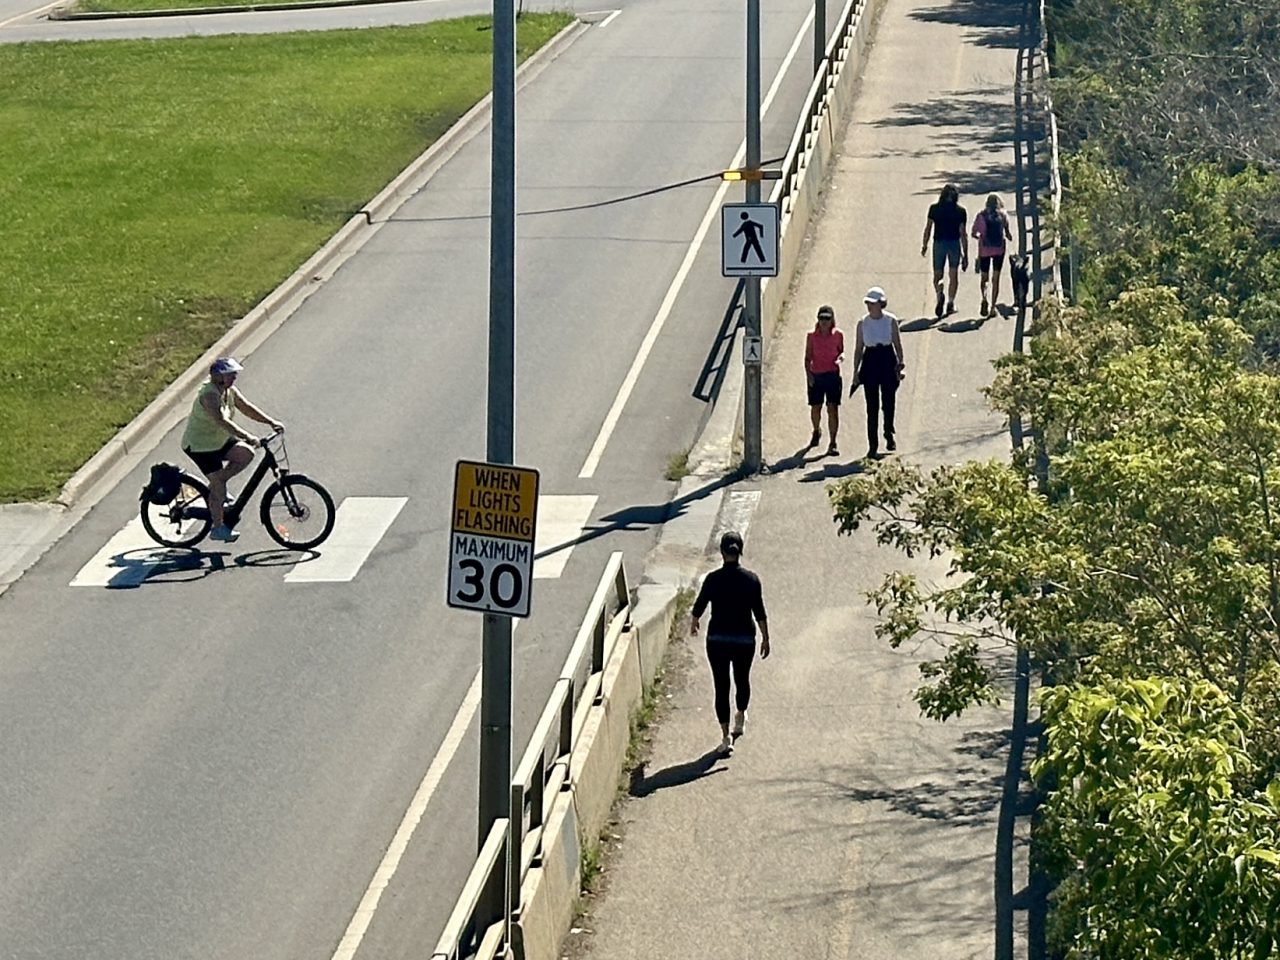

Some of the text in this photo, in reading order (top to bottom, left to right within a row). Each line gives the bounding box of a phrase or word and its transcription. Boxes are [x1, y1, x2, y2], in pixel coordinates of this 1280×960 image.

[475, 468, 521, 492] WHEN
[469, 488, 521, 513] LIGHTS
[456, 509, 531, 536] FLASHING
[455, 536, 528, 564] MAXIMUM
[456, 559, 523, 609] 30
